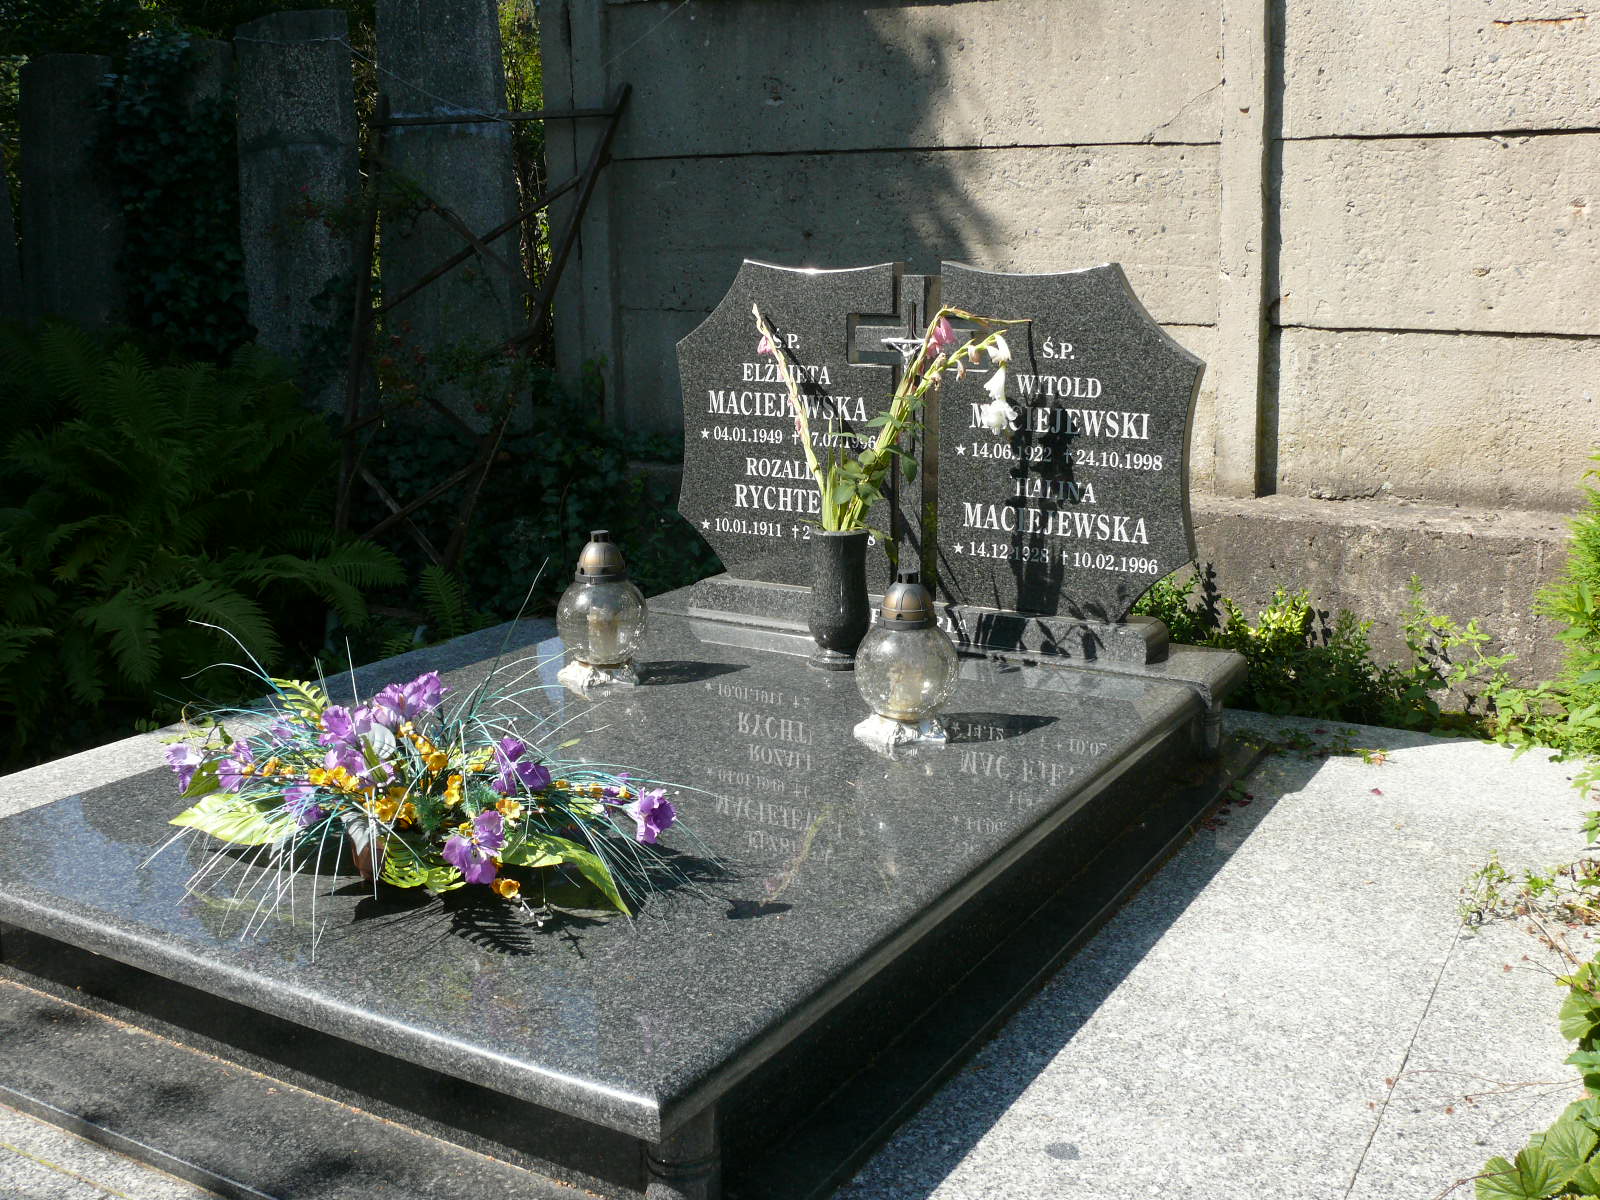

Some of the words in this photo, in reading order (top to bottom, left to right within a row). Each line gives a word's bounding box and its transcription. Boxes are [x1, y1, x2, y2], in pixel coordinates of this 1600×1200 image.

[1042, 336, 1075, 360] Ś.P.
[1016, 374, 1102, 398] WITOLD
[968, 402, 1151, 440] MCIEJEWSKI
[713, 426, 783, 445] 04.01.1949
[972, 442, 1052, 462] 14.06.1922
[1076, 449, 1163, 471] 24.10.1998
[1015, 478, 1096, 503] HALINA
[714, 518, 782, 537] 10.01.1911
[962, 502, 1149, 544] MACIEJEWSKA
[969, 542, 1049, 563] 14.12.1928
[1073, 552, 1158, 575] 10.02.1996
